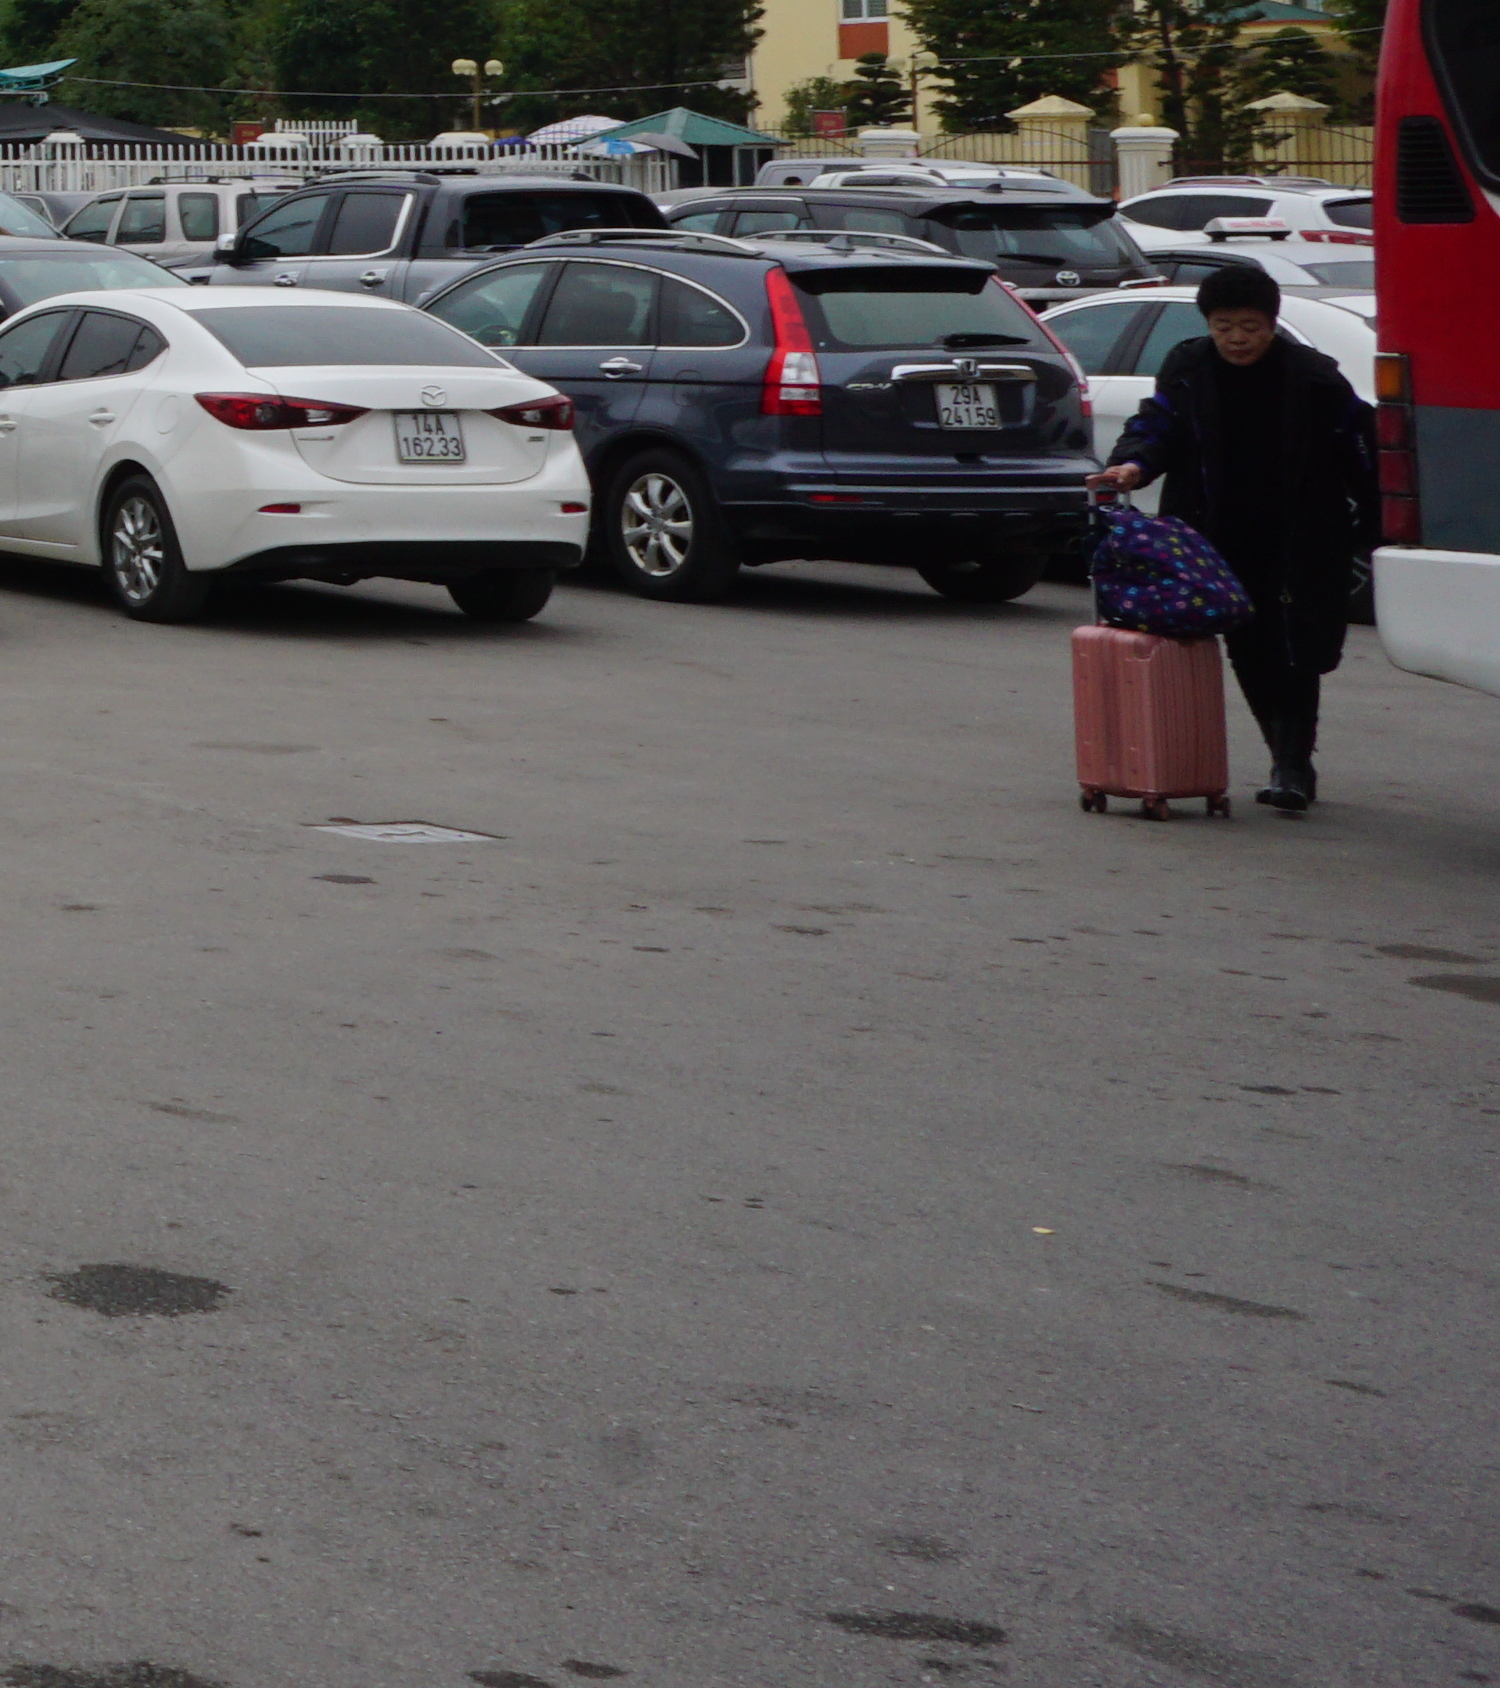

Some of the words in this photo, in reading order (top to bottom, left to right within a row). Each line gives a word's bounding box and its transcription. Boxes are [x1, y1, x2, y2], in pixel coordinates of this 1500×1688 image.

[950, 386, 982, 405] 29A
[412, 414, 445, 435] 14A
[402, 436, 462, 457] 162.33
